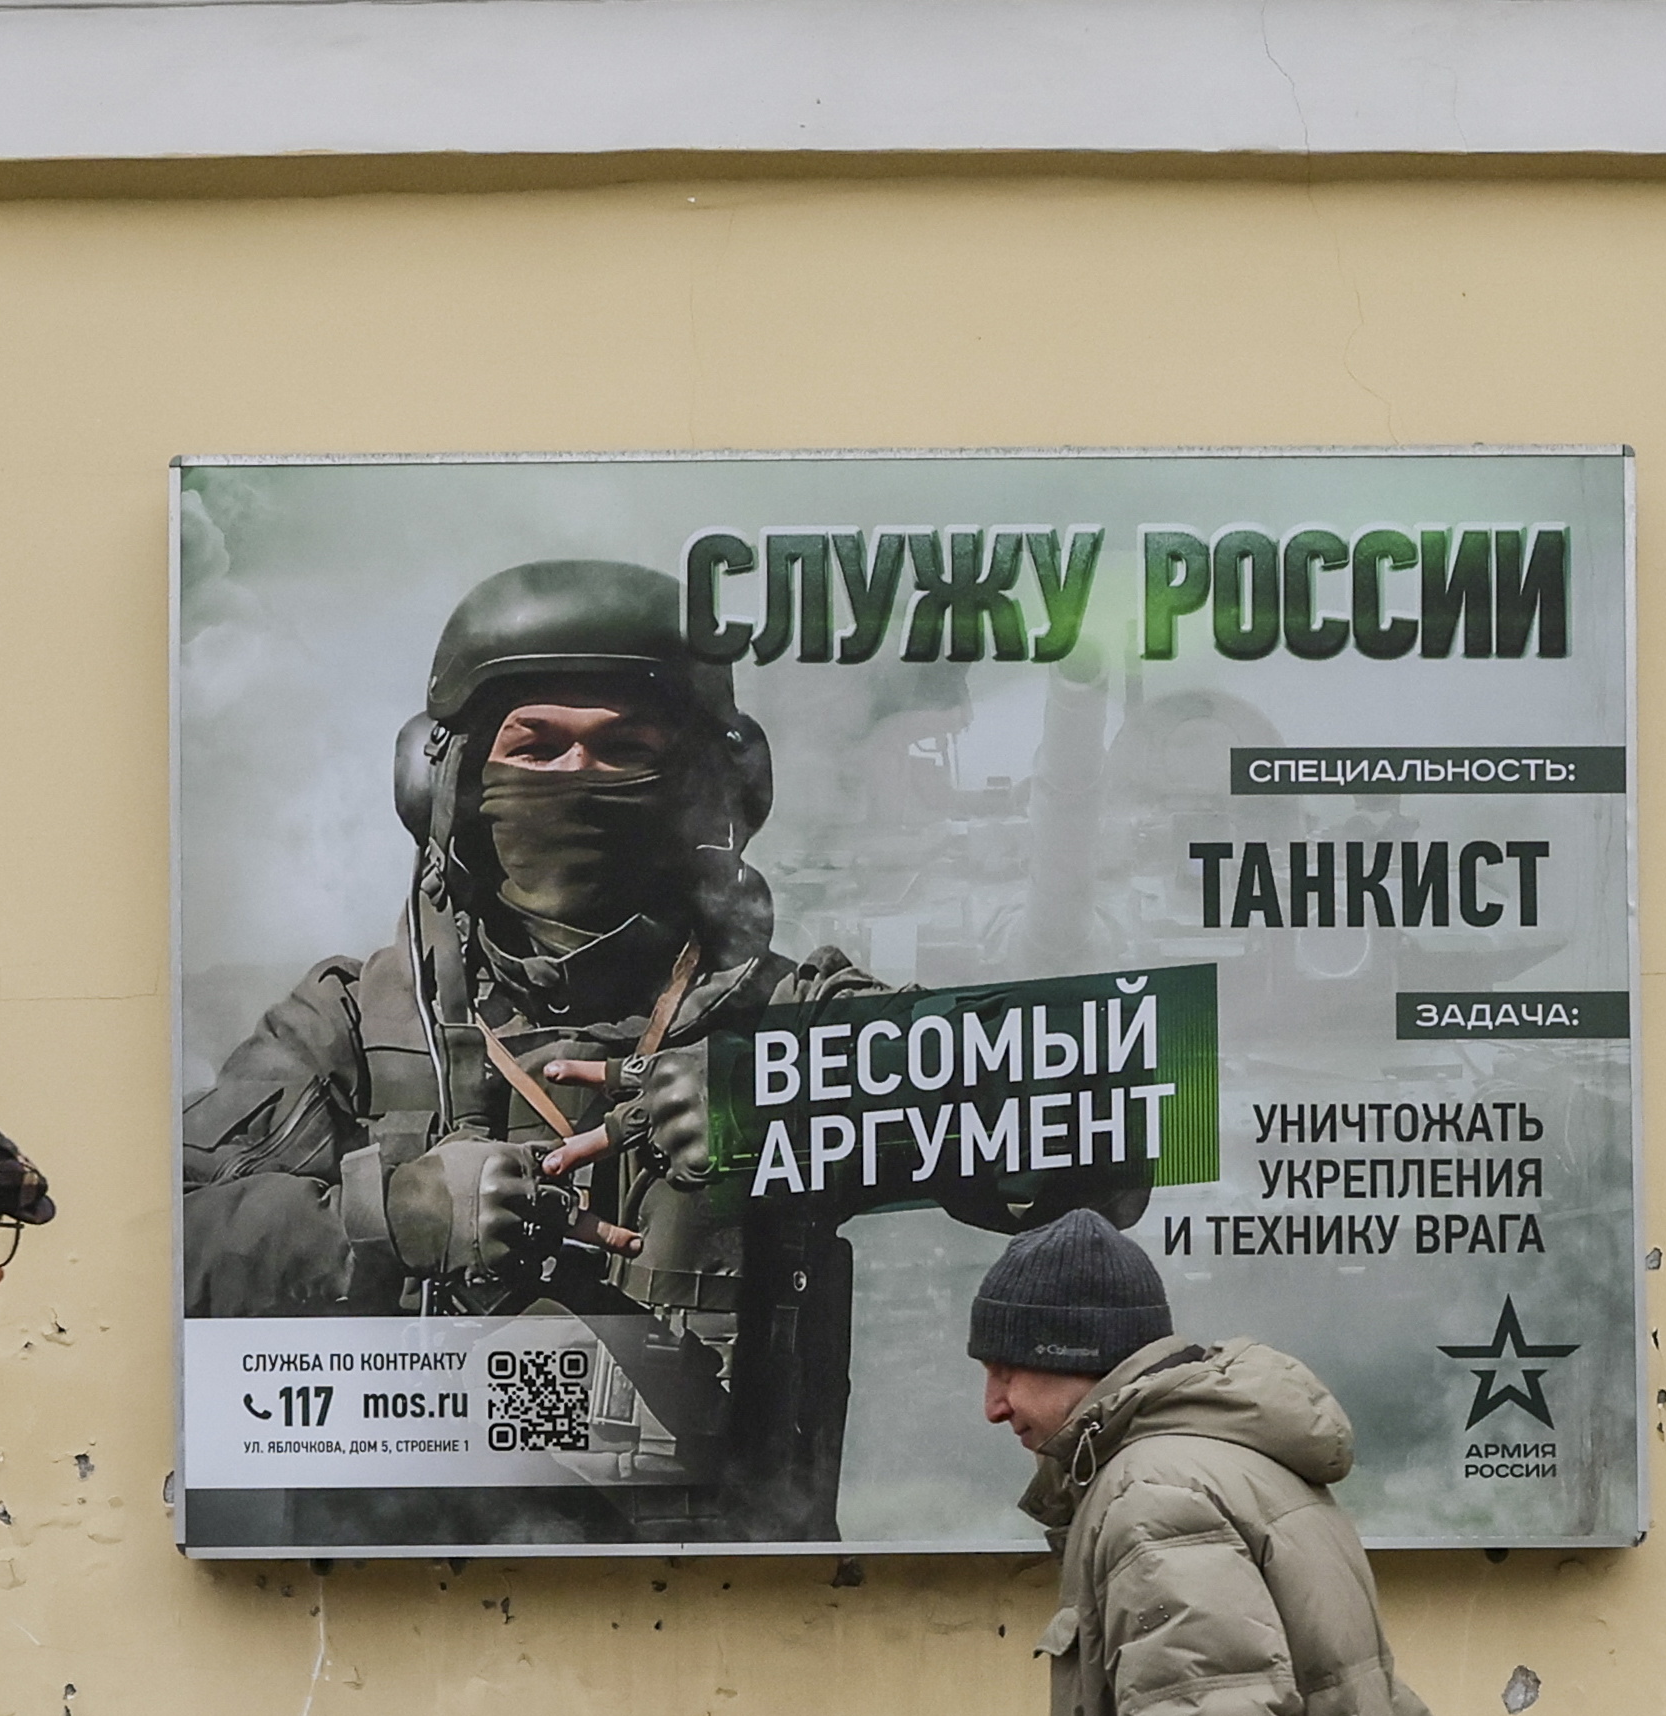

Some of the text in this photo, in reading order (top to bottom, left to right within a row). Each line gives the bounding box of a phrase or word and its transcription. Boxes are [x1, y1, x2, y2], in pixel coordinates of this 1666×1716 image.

[681, 523, 1572, 666] СЛУЖУ РОССИИ
[1248, 757, 1577, 786] СПЕЦИАЛЬНОСТЬ:
[1188, 840, 1550, 929] ТАНКИСТ
[1414, 1002, 1580, 1031] ЗАДАЧА:
[753, 975, 1161, 1107] ВЕСОМЫЙ
[749, 1082, 1177, 1198] АРГУМЕНТ
[1252, 1102, 1544, 1144] УНИЧТОЖАТЬ
[1258, 1157, 1544, 1200] УКРЕПЛЕНИЯ
[1164, 1213, 1546, 1256] И ТЕХНИКУ ВРАГА
[241, 1351, 468, 1373] СЛУЖБА ПО КОНТРАКТУ
[279, 1385, 469, 1428] 117 mos.ru
[243, 1441, 264, 1455] УЛ.
[267, 1440, 346, 1455] ЯБЛОЧКОВА,
[349, 1440, 378, 1455] ДОМ
[381, 1440, 393, 1454] 5,
[395, 1439, 460, 1453] СТРОЕНИЕ
[1464, 1442, 1557, 1460] АРМИЯ
[1464, 1463, 1557, 1480] РОССИИ
